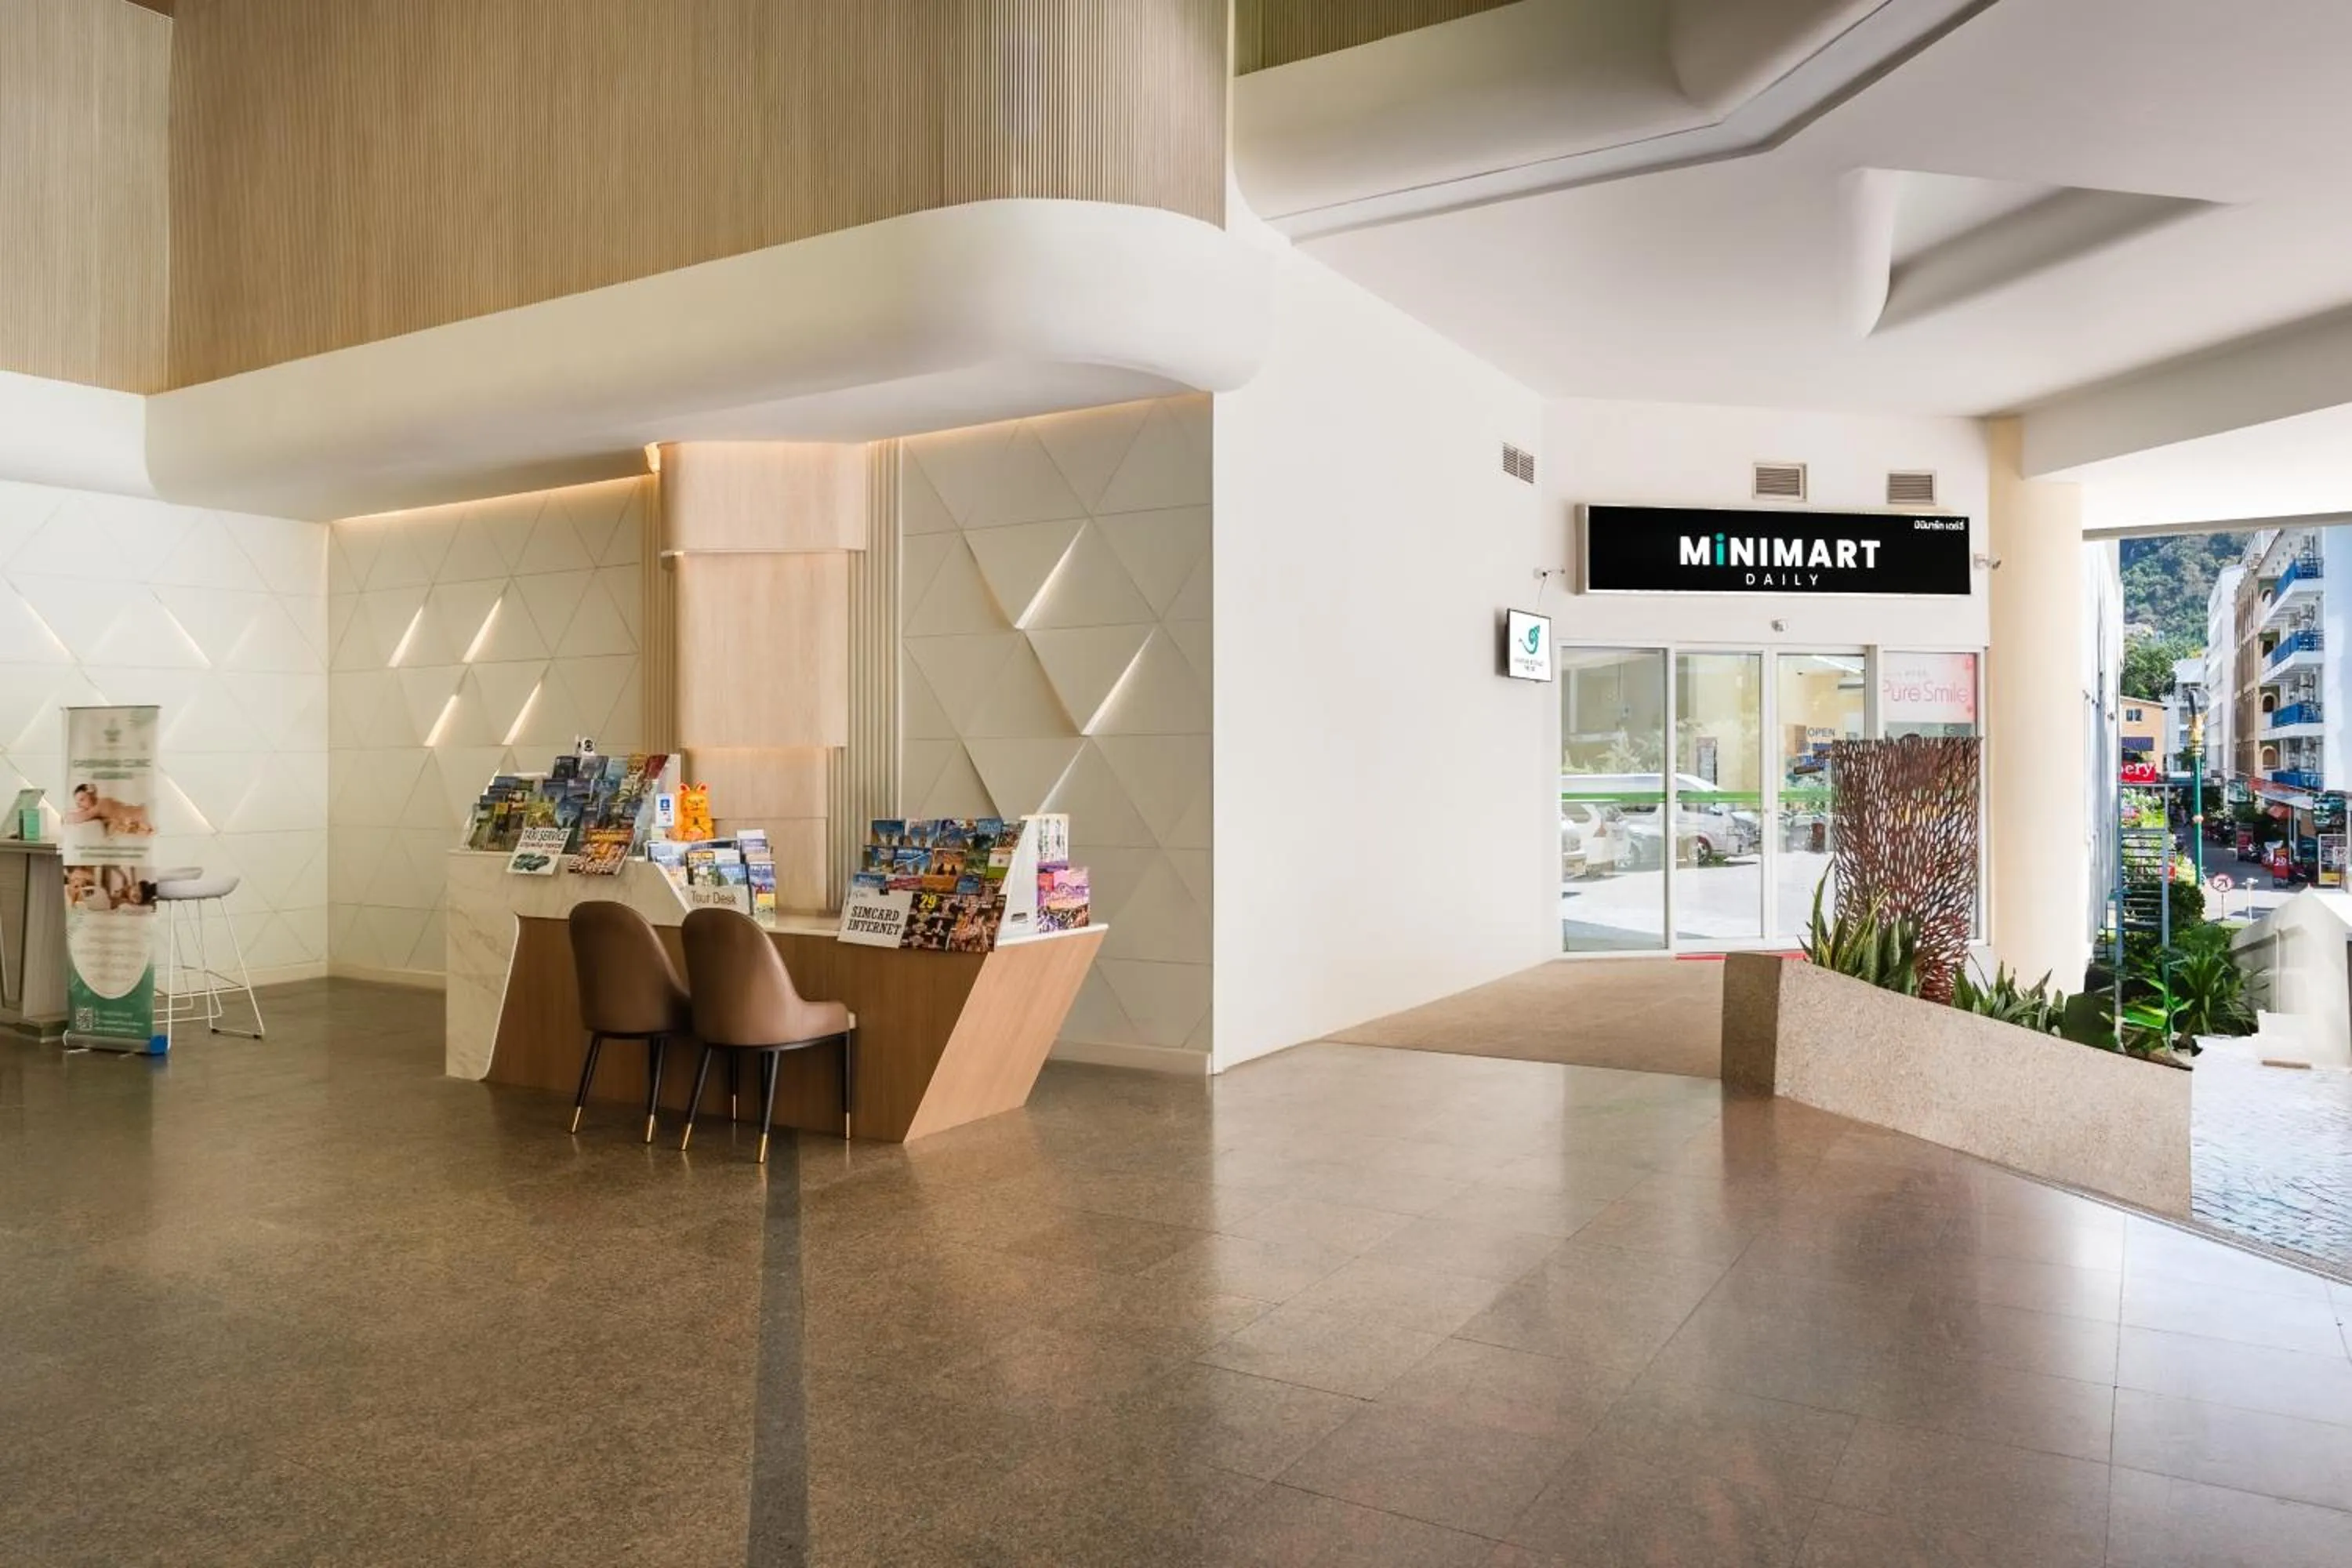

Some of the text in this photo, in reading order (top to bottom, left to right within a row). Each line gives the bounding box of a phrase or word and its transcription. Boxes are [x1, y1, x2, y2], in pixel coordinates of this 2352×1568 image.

[1679, 532, 1881, 568] MiNIMART
[1745, 573, 1819, 586] DAILY
[1923, 681, 1969, 703] Smile
[1807, 727, 1836, 739] OPEN
[539, 829, 568, 841] SERVICE
[691, 891, 736, 905] Tour Desk
[919, 894, 937, 909] 29
[851, 906, 899, 921] SIMCARD
[847, 918, 902, 935] INTERNET
